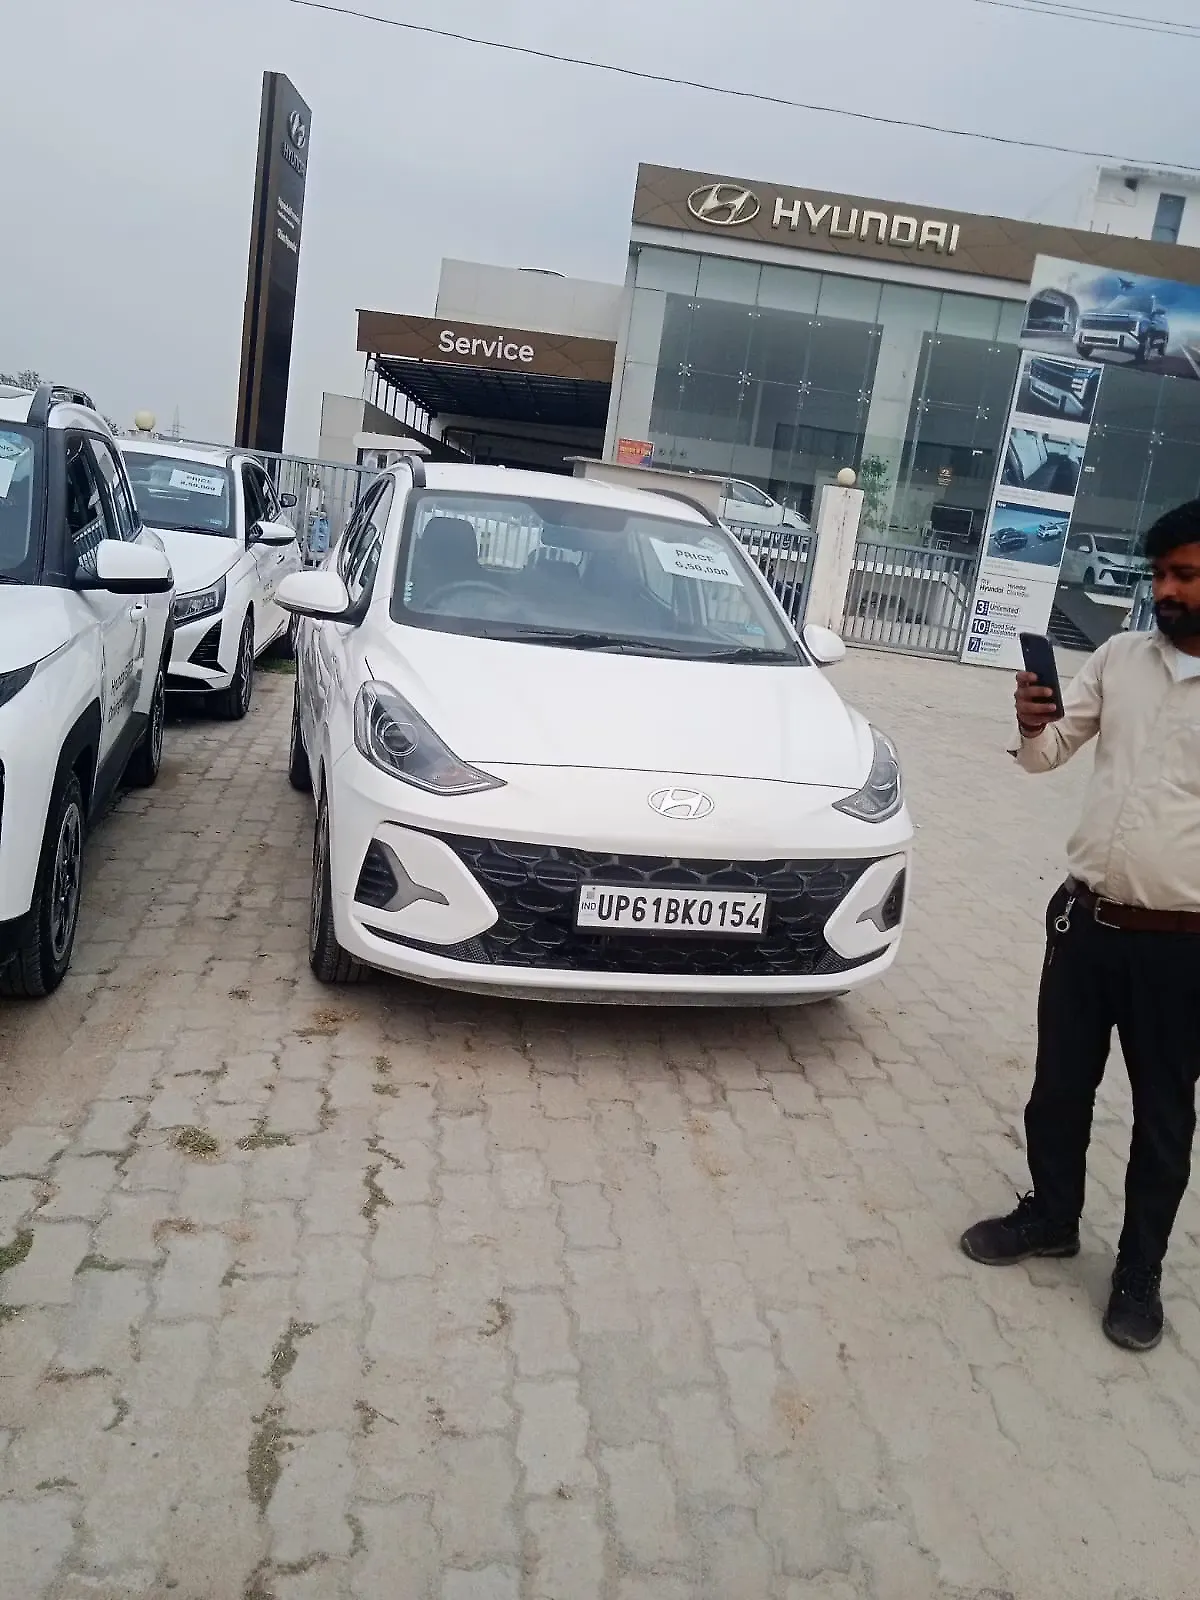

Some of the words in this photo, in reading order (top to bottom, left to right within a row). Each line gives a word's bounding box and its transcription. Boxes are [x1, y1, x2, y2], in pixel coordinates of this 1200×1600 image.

[772, 197, 960, 255] HYUNDAI
[438, 330, 534, 362] Service
[675, 549, 714, 563] PRICE
[675, 561, 729, 576] 6,50,000
[976, 600, 985, 614] 3
[989, 601, 1020, 614] Unlimited
[973, 619, 987, 633] 10
[581, 902, 597, 911] IND
[597, 894, 763, 929] UP61BK0154
